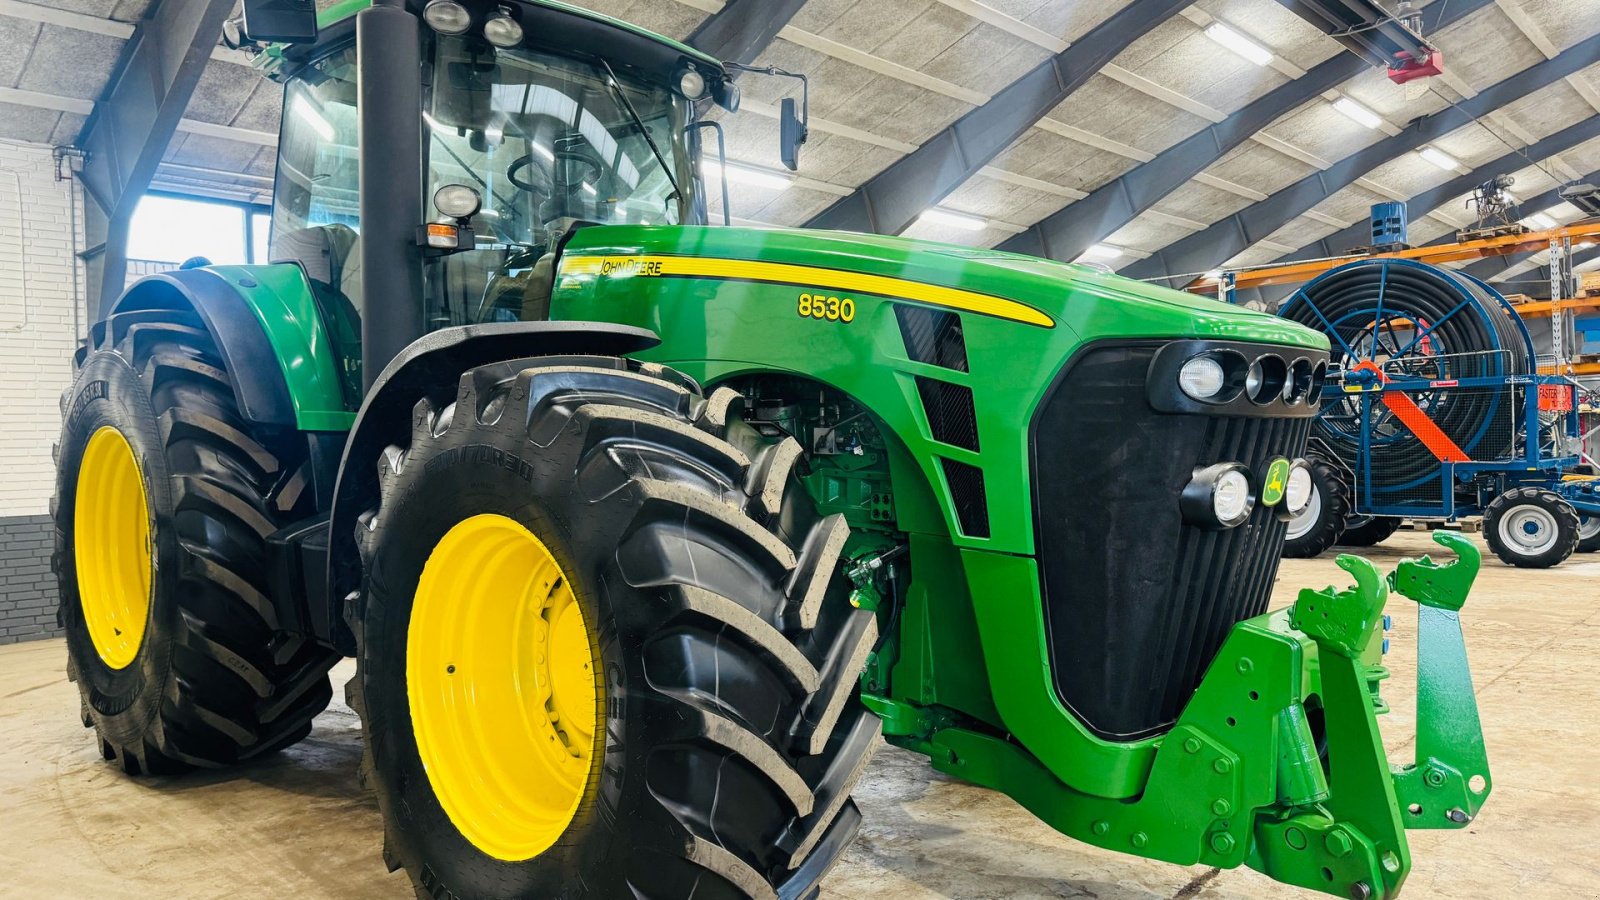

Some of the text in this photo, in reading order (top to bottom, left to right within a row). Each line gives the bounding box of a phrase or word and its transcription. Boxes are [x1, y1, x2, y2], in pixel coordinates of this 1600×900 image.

[600, 258, 663, 274] JOHN DEERE
[798, 293, 856, 323] 8530
